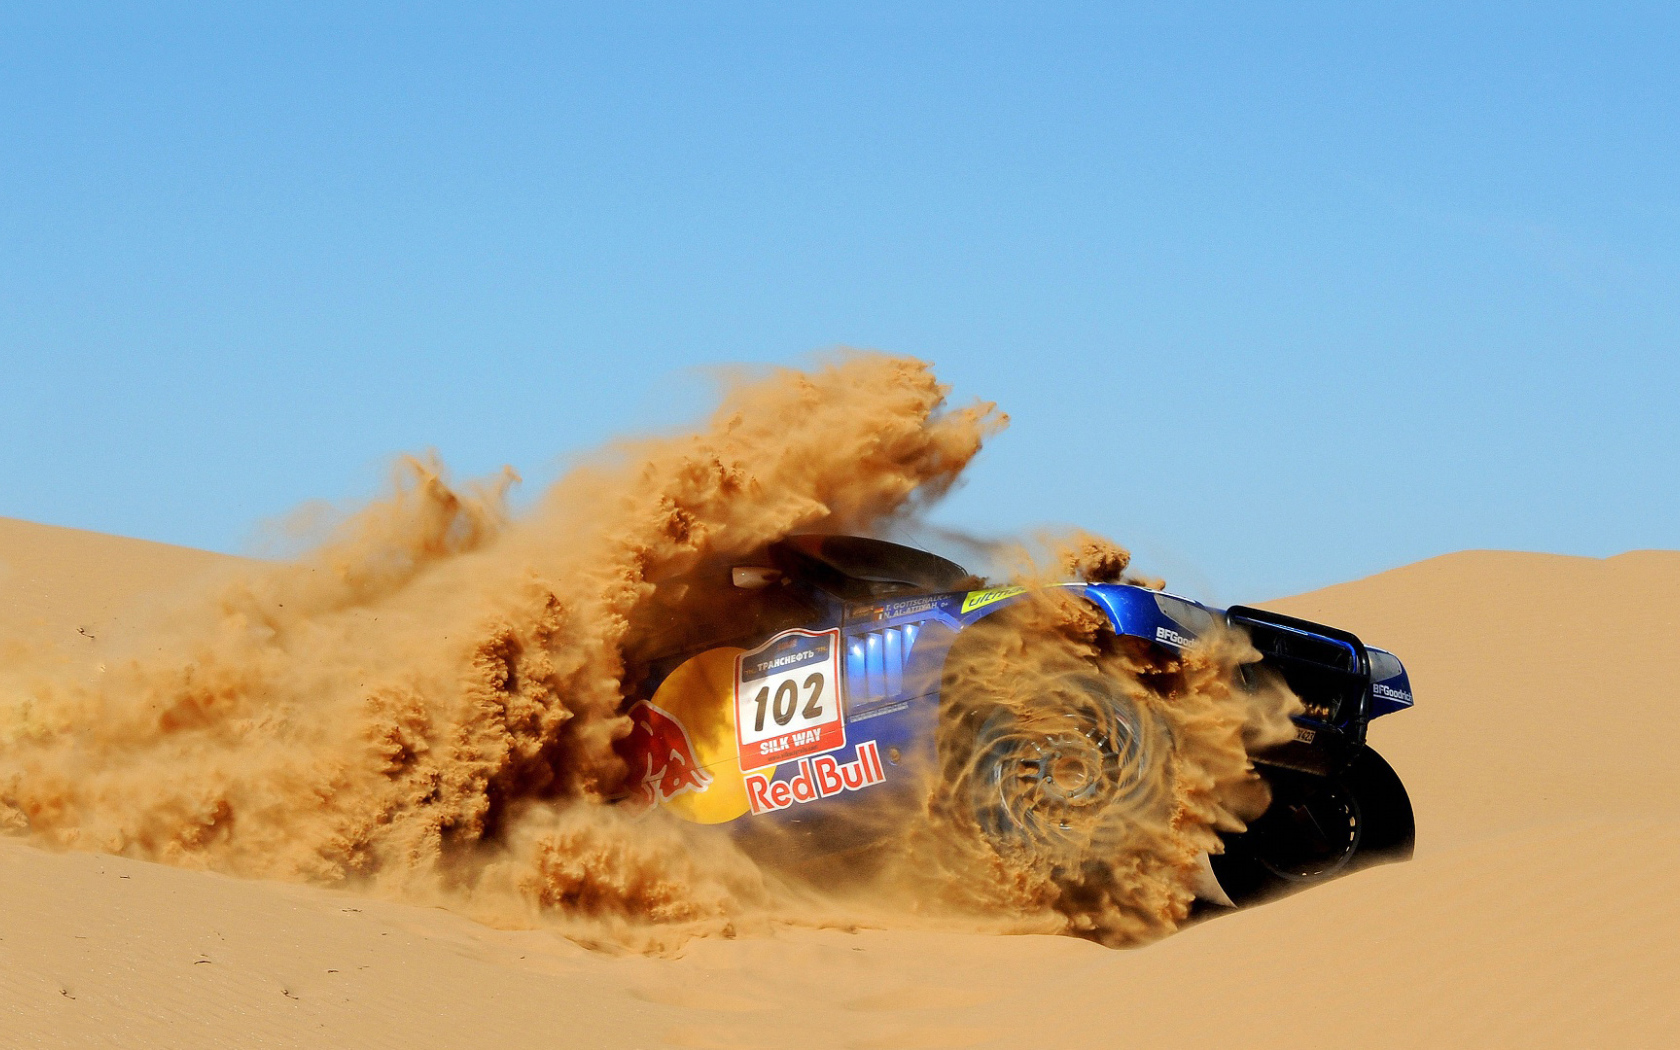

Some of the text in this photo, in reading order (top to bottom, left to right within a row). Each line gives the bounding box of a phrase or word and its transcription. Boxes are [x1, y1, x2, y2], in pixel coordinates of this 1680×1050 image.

[1156, 626, 1196, 648] BFGood
[757, 651, 815, 672] ТРАНСНЕФТЬ
[754, 672, 825, 732] 102
[1373, 683, 1412, 702] BFGoodrich
[759, 727, 822, 756] SILK WAY
[745, 742, 886, 814] Red Bull
